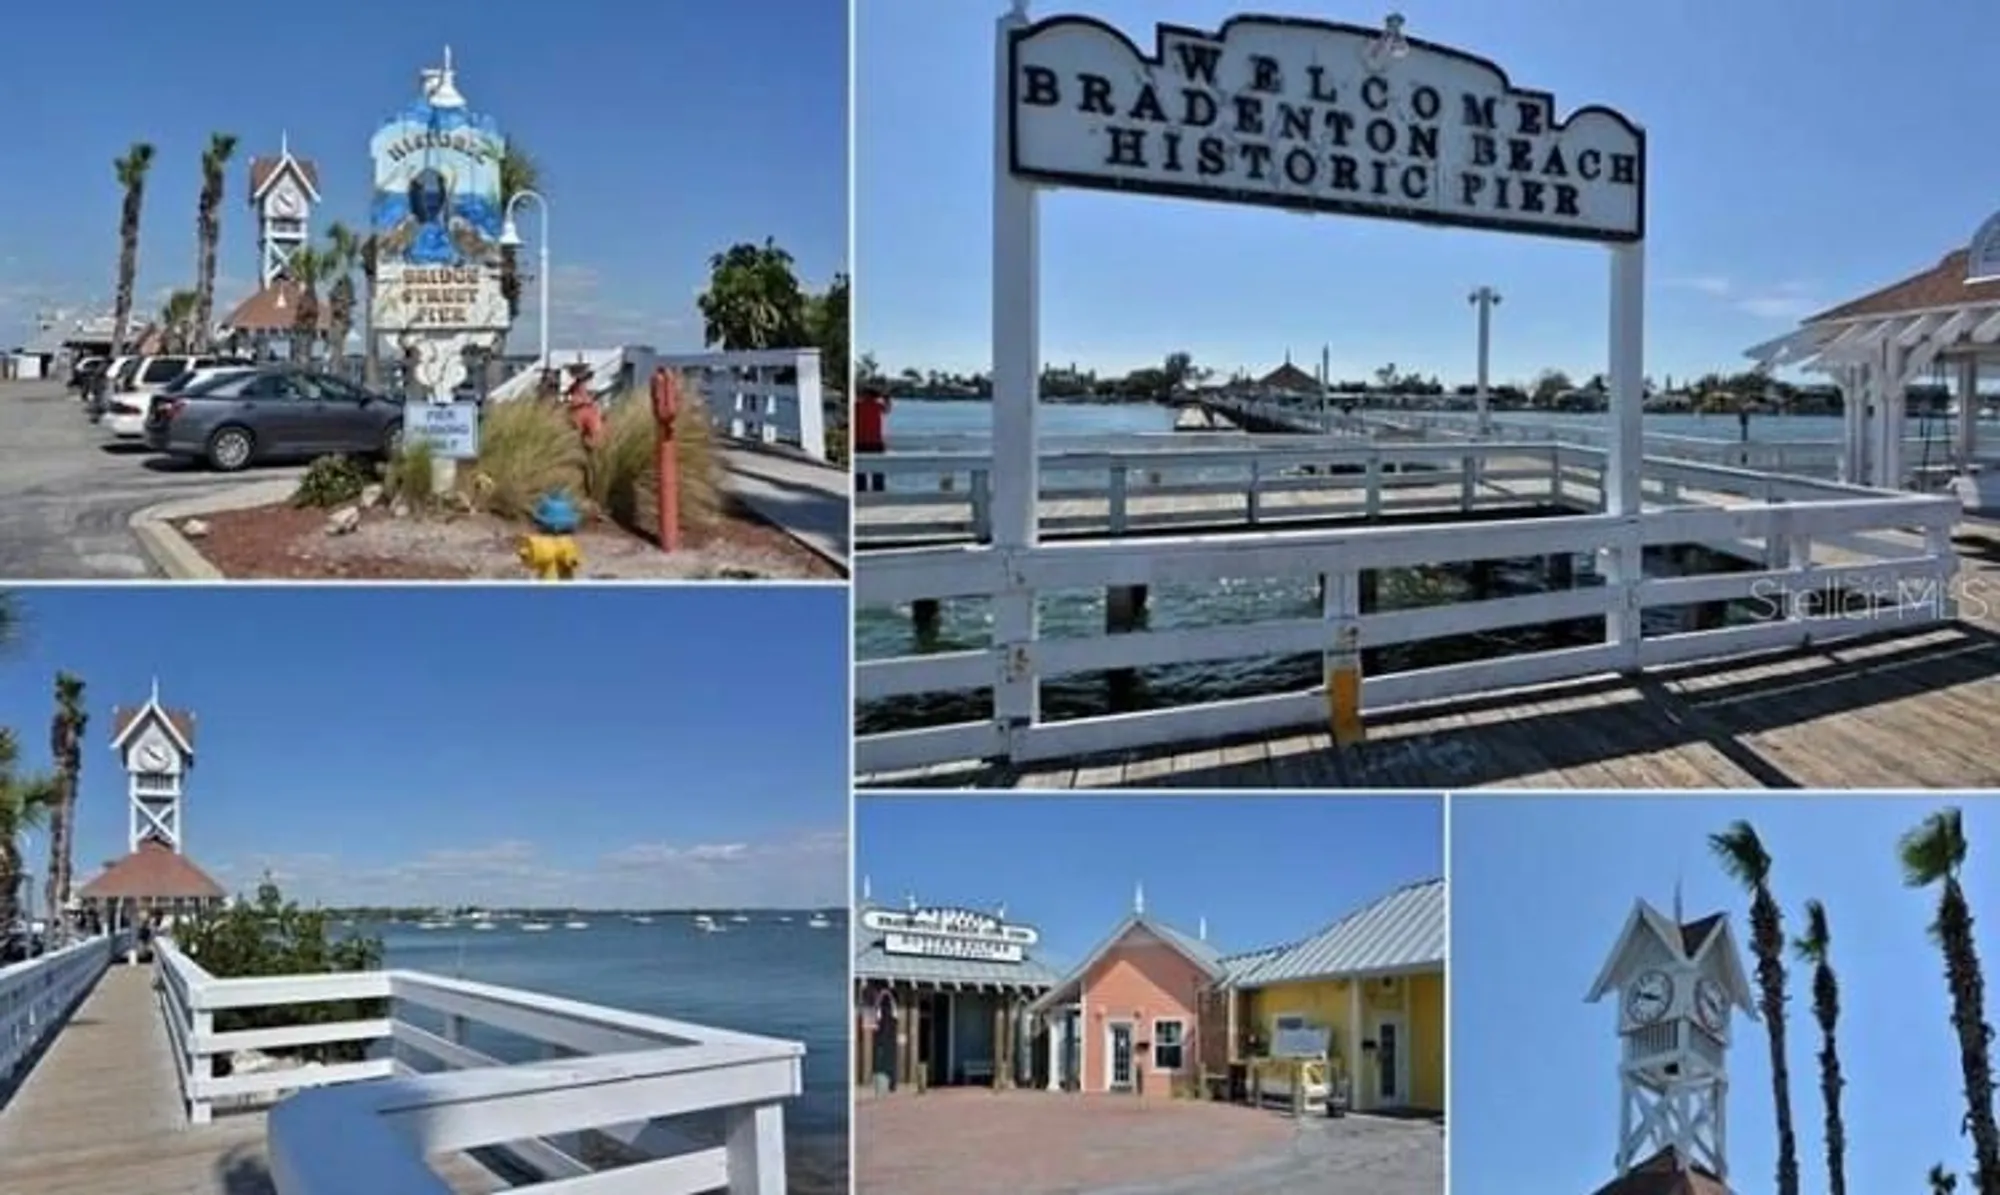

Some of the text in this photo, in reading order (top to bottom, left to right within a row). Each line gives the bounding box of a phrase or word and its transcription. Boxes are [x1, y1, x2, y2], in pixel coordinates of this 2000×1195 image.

[1173, 42, 1547, 137] WELCOME
[1022, 65, 1637, 185] BRADENTON BEACH
[1105, 127, 1581, 217] HISTORIC PIER
[401, 287, 479, 304] STREET
[402, 268, 479, 285] BRIDGE
[415, 306, 468, 323] PIER
